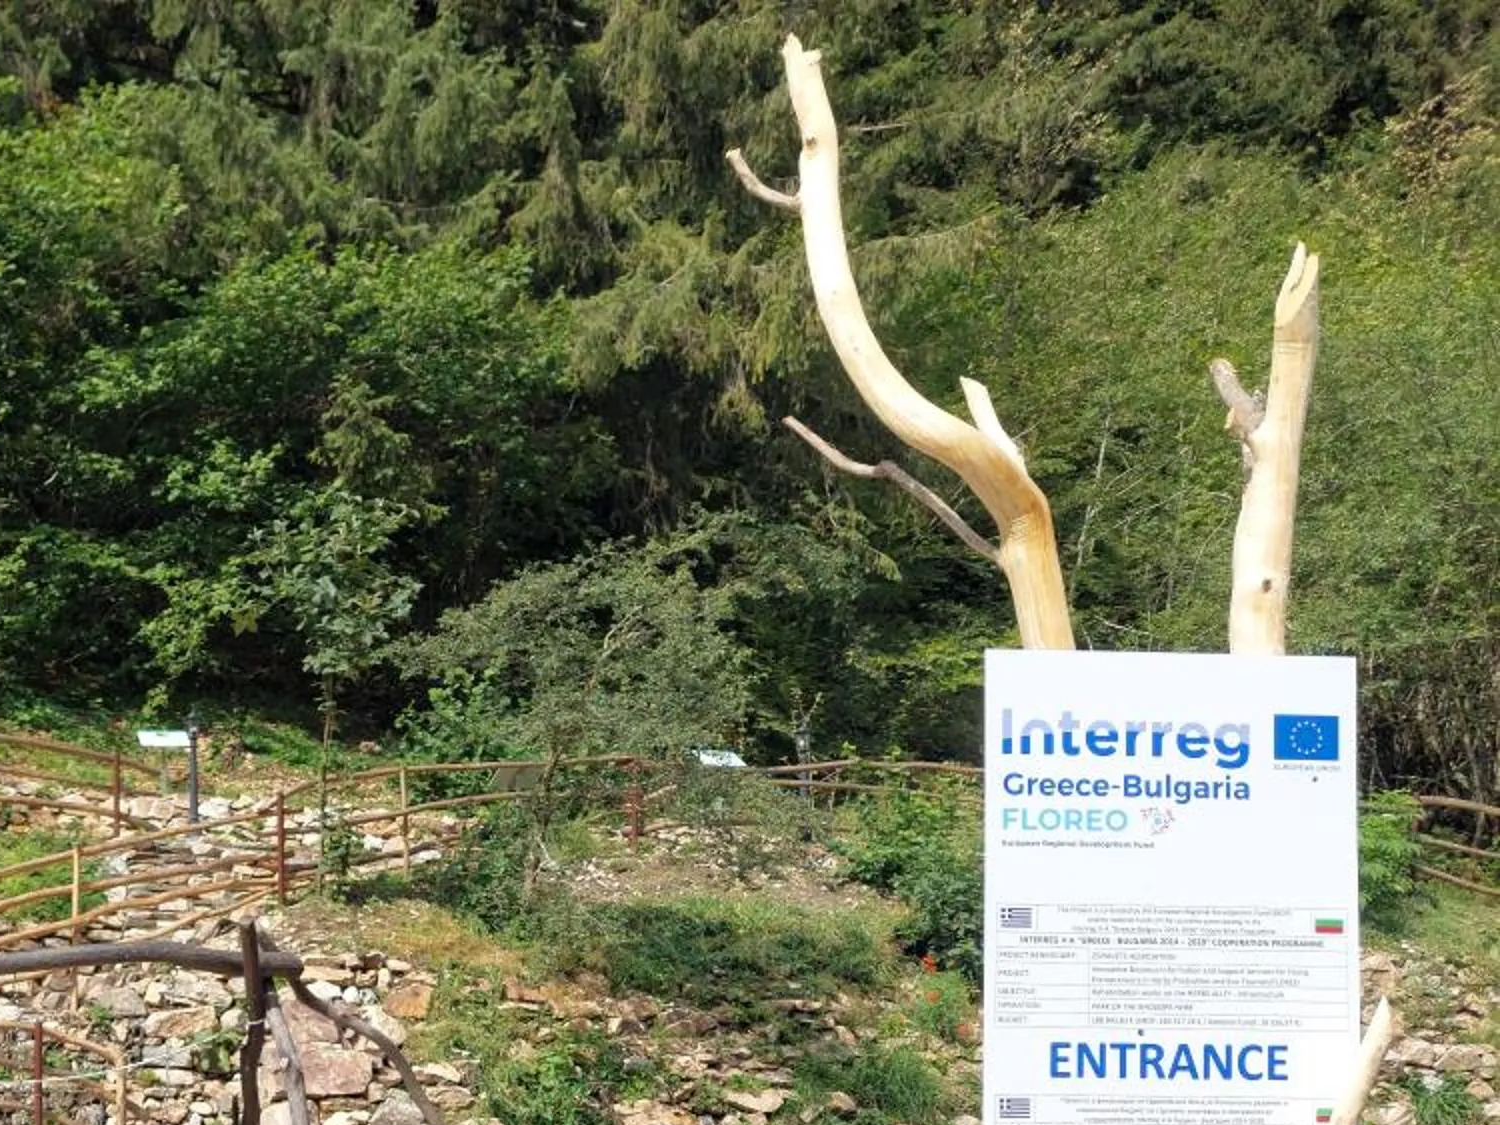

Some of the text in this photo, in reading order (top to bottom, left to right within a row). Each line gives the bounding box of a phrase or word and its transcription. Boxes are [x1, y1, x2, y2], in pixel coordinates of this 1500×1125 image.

[1001, 708, 1250, 769] Interreg
[1003, 773, 1250, 804] Greece-Bulgaria
[1002, 807, 1128, 832] FLOREO
[1050, 1042, 1288, 1081] ENTRANCE
